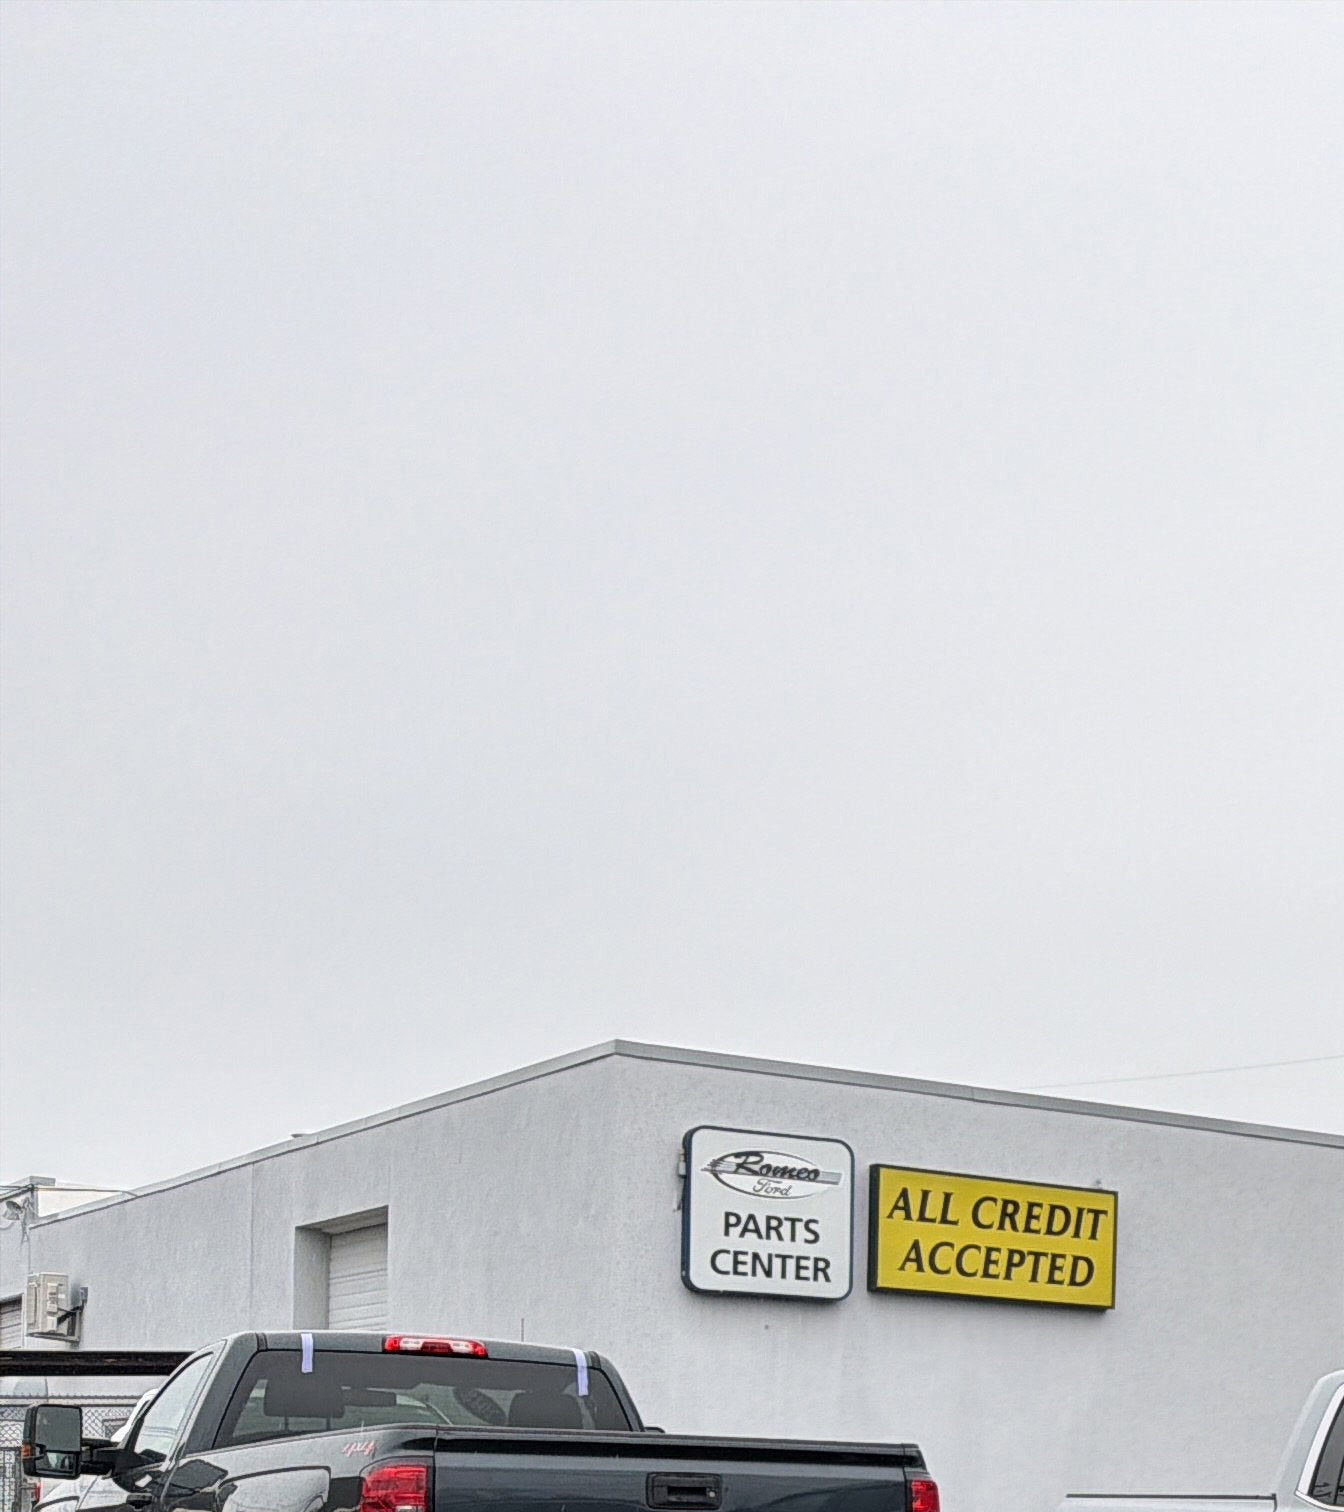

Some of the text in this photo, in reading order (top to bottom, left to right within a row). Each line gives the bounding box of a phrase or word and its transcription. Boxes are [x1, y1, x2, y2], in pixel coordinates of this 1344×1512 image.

[733, 1151, 820, 1181] Romeo
[752, 1178, 793, 1197] Ford
[723, 1210, 821, 1244] PARTS
[886, 1186, 1108, 1241] ALL CREDIT
[710, 1248, 832, 1283] CENTER
[898, 1238, 1096, 1288] ACCEPTED
